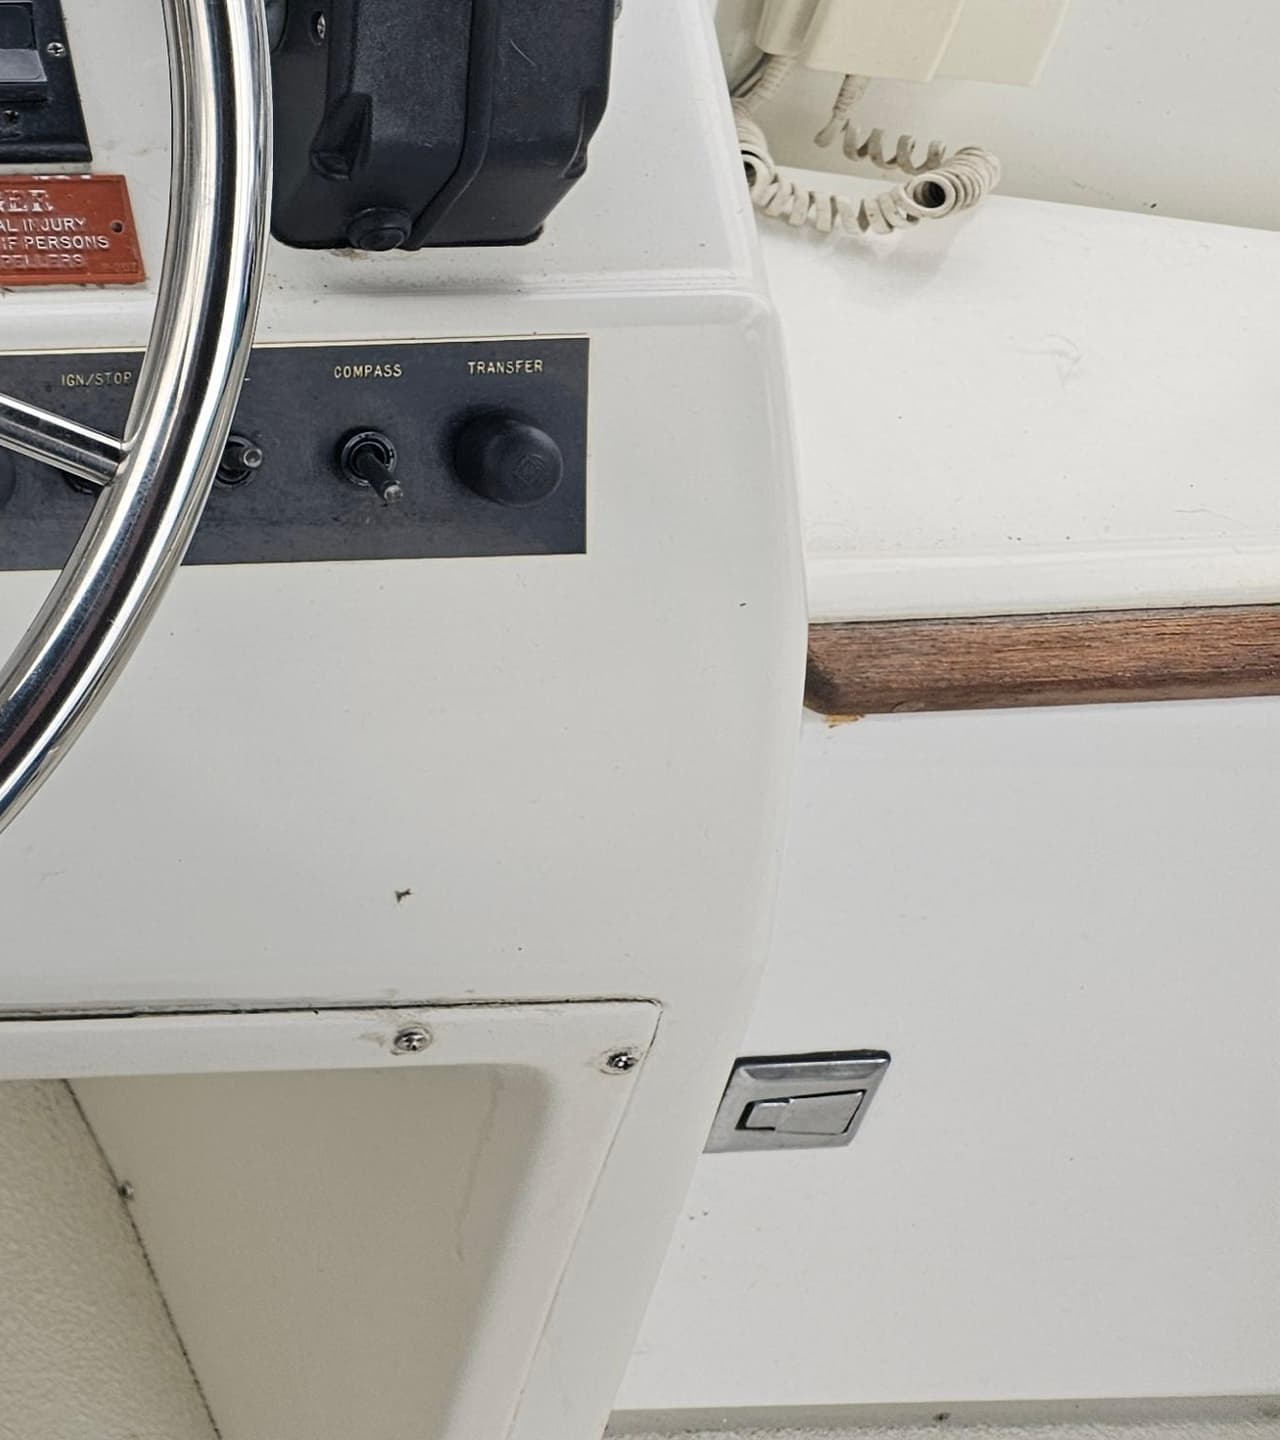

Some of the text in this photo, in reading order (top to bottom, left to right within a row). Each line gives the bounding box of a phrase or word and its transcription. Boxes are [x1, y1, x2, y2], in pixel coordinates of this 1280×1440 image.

[21, 216, 87, 233] INJURY
[1, 236, 19, 250] IF
[23, 234, 111, 250] PERSONS
[333, 363, 403, 379] COMPASS
[467, 359, 544, 376] TRANSFER
[60, 371, 133, 387] IGN/STOP
